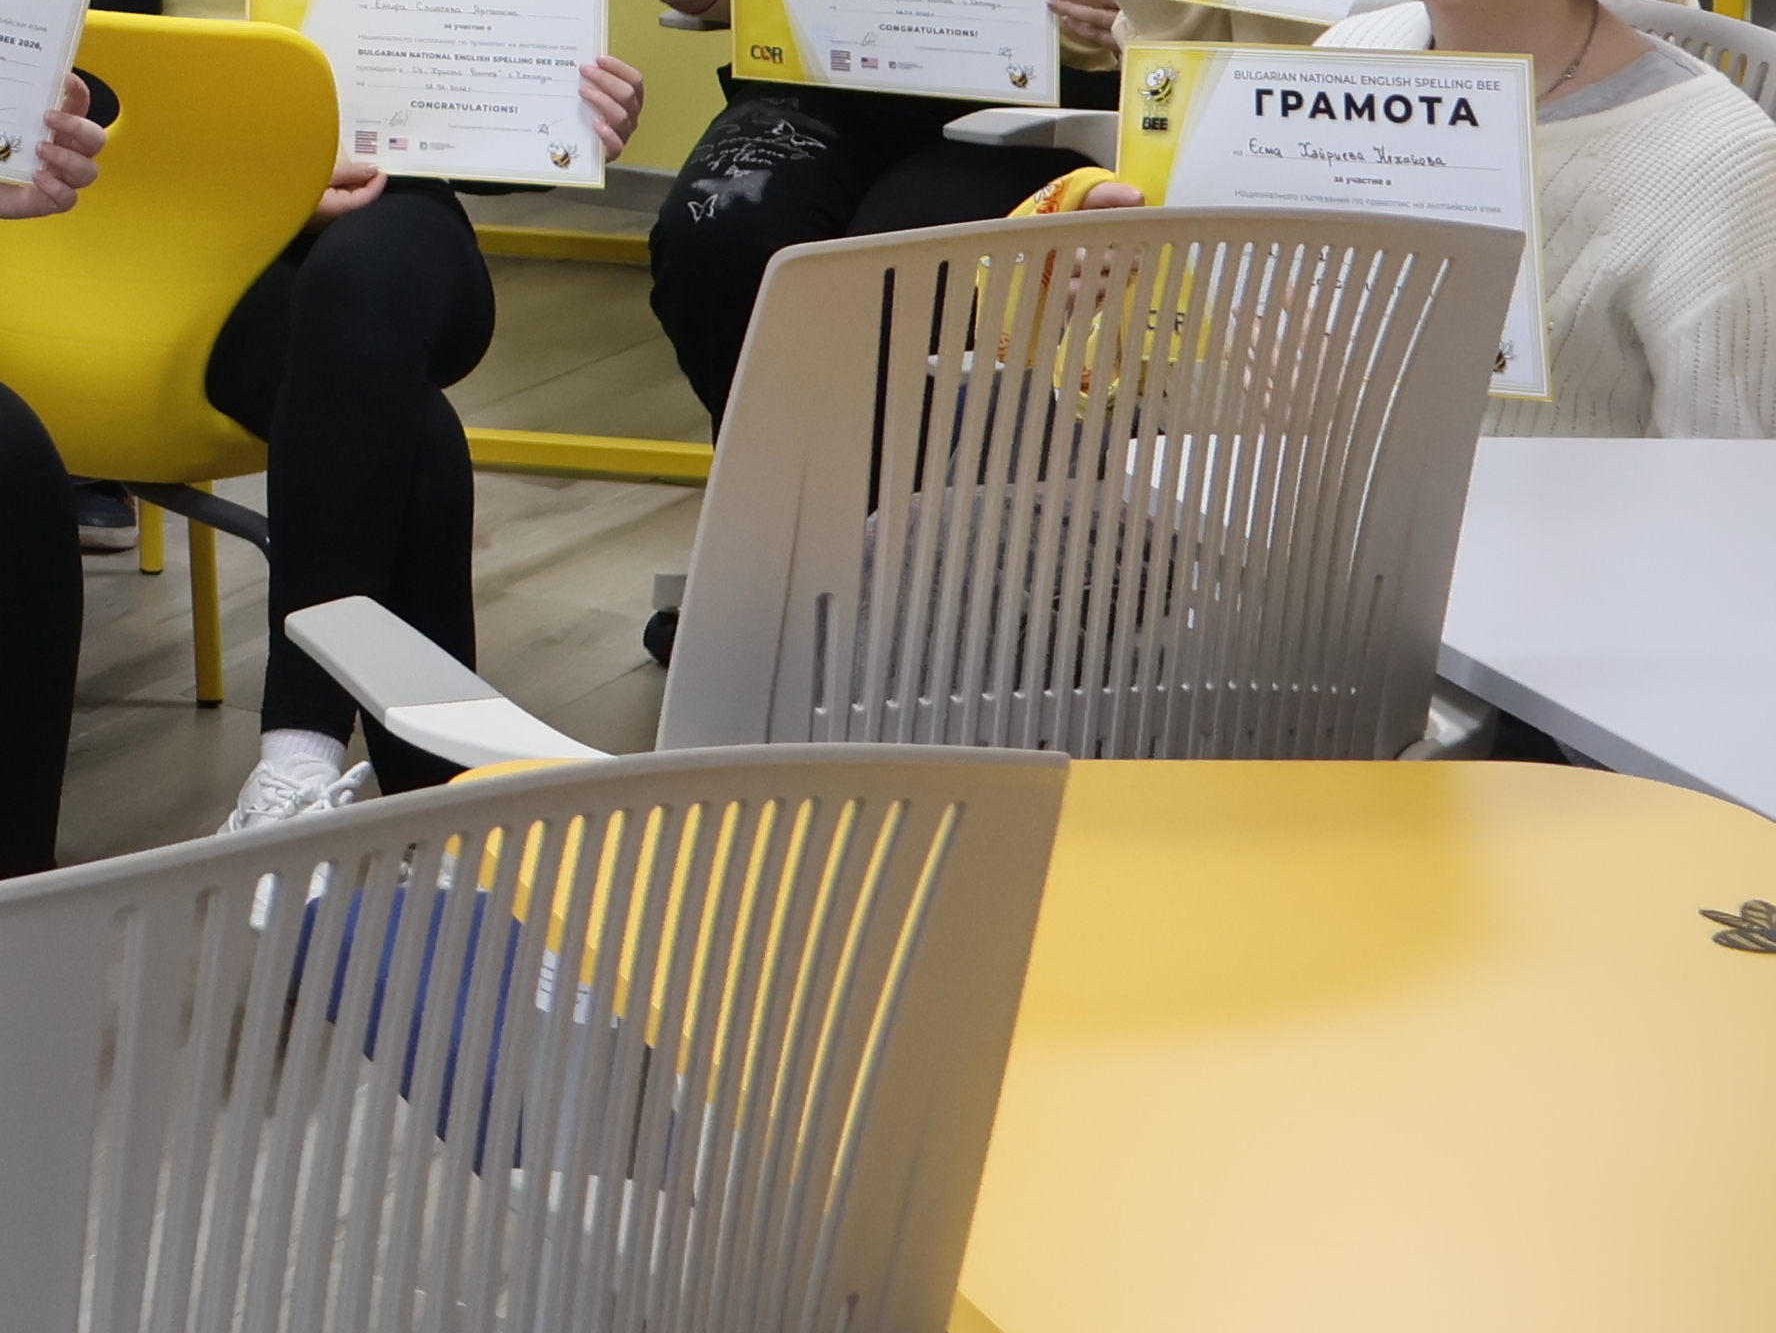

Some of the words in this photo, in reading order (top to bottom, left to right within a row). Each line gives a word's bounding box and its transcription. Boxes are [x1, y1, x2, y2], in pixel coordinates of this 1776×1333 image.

[879, 23, 978, 37] CONGRATULATIONS!
[1232, 70, 1295, 82] BULGARIAN
[1300, 73, 1357, 84] NATIONAL
[1361, 75, 1411, 87] ENGLISH
[1414, 78, 1472, 89] SPELLING
[1476, 80, 1501, 91] BEE
[410, 100, 518, 113] CONGRATULATIONS!
[1254, 87, 1479, 127] ГРАМОТА
[1142, 115, 1168, 131] BEE
